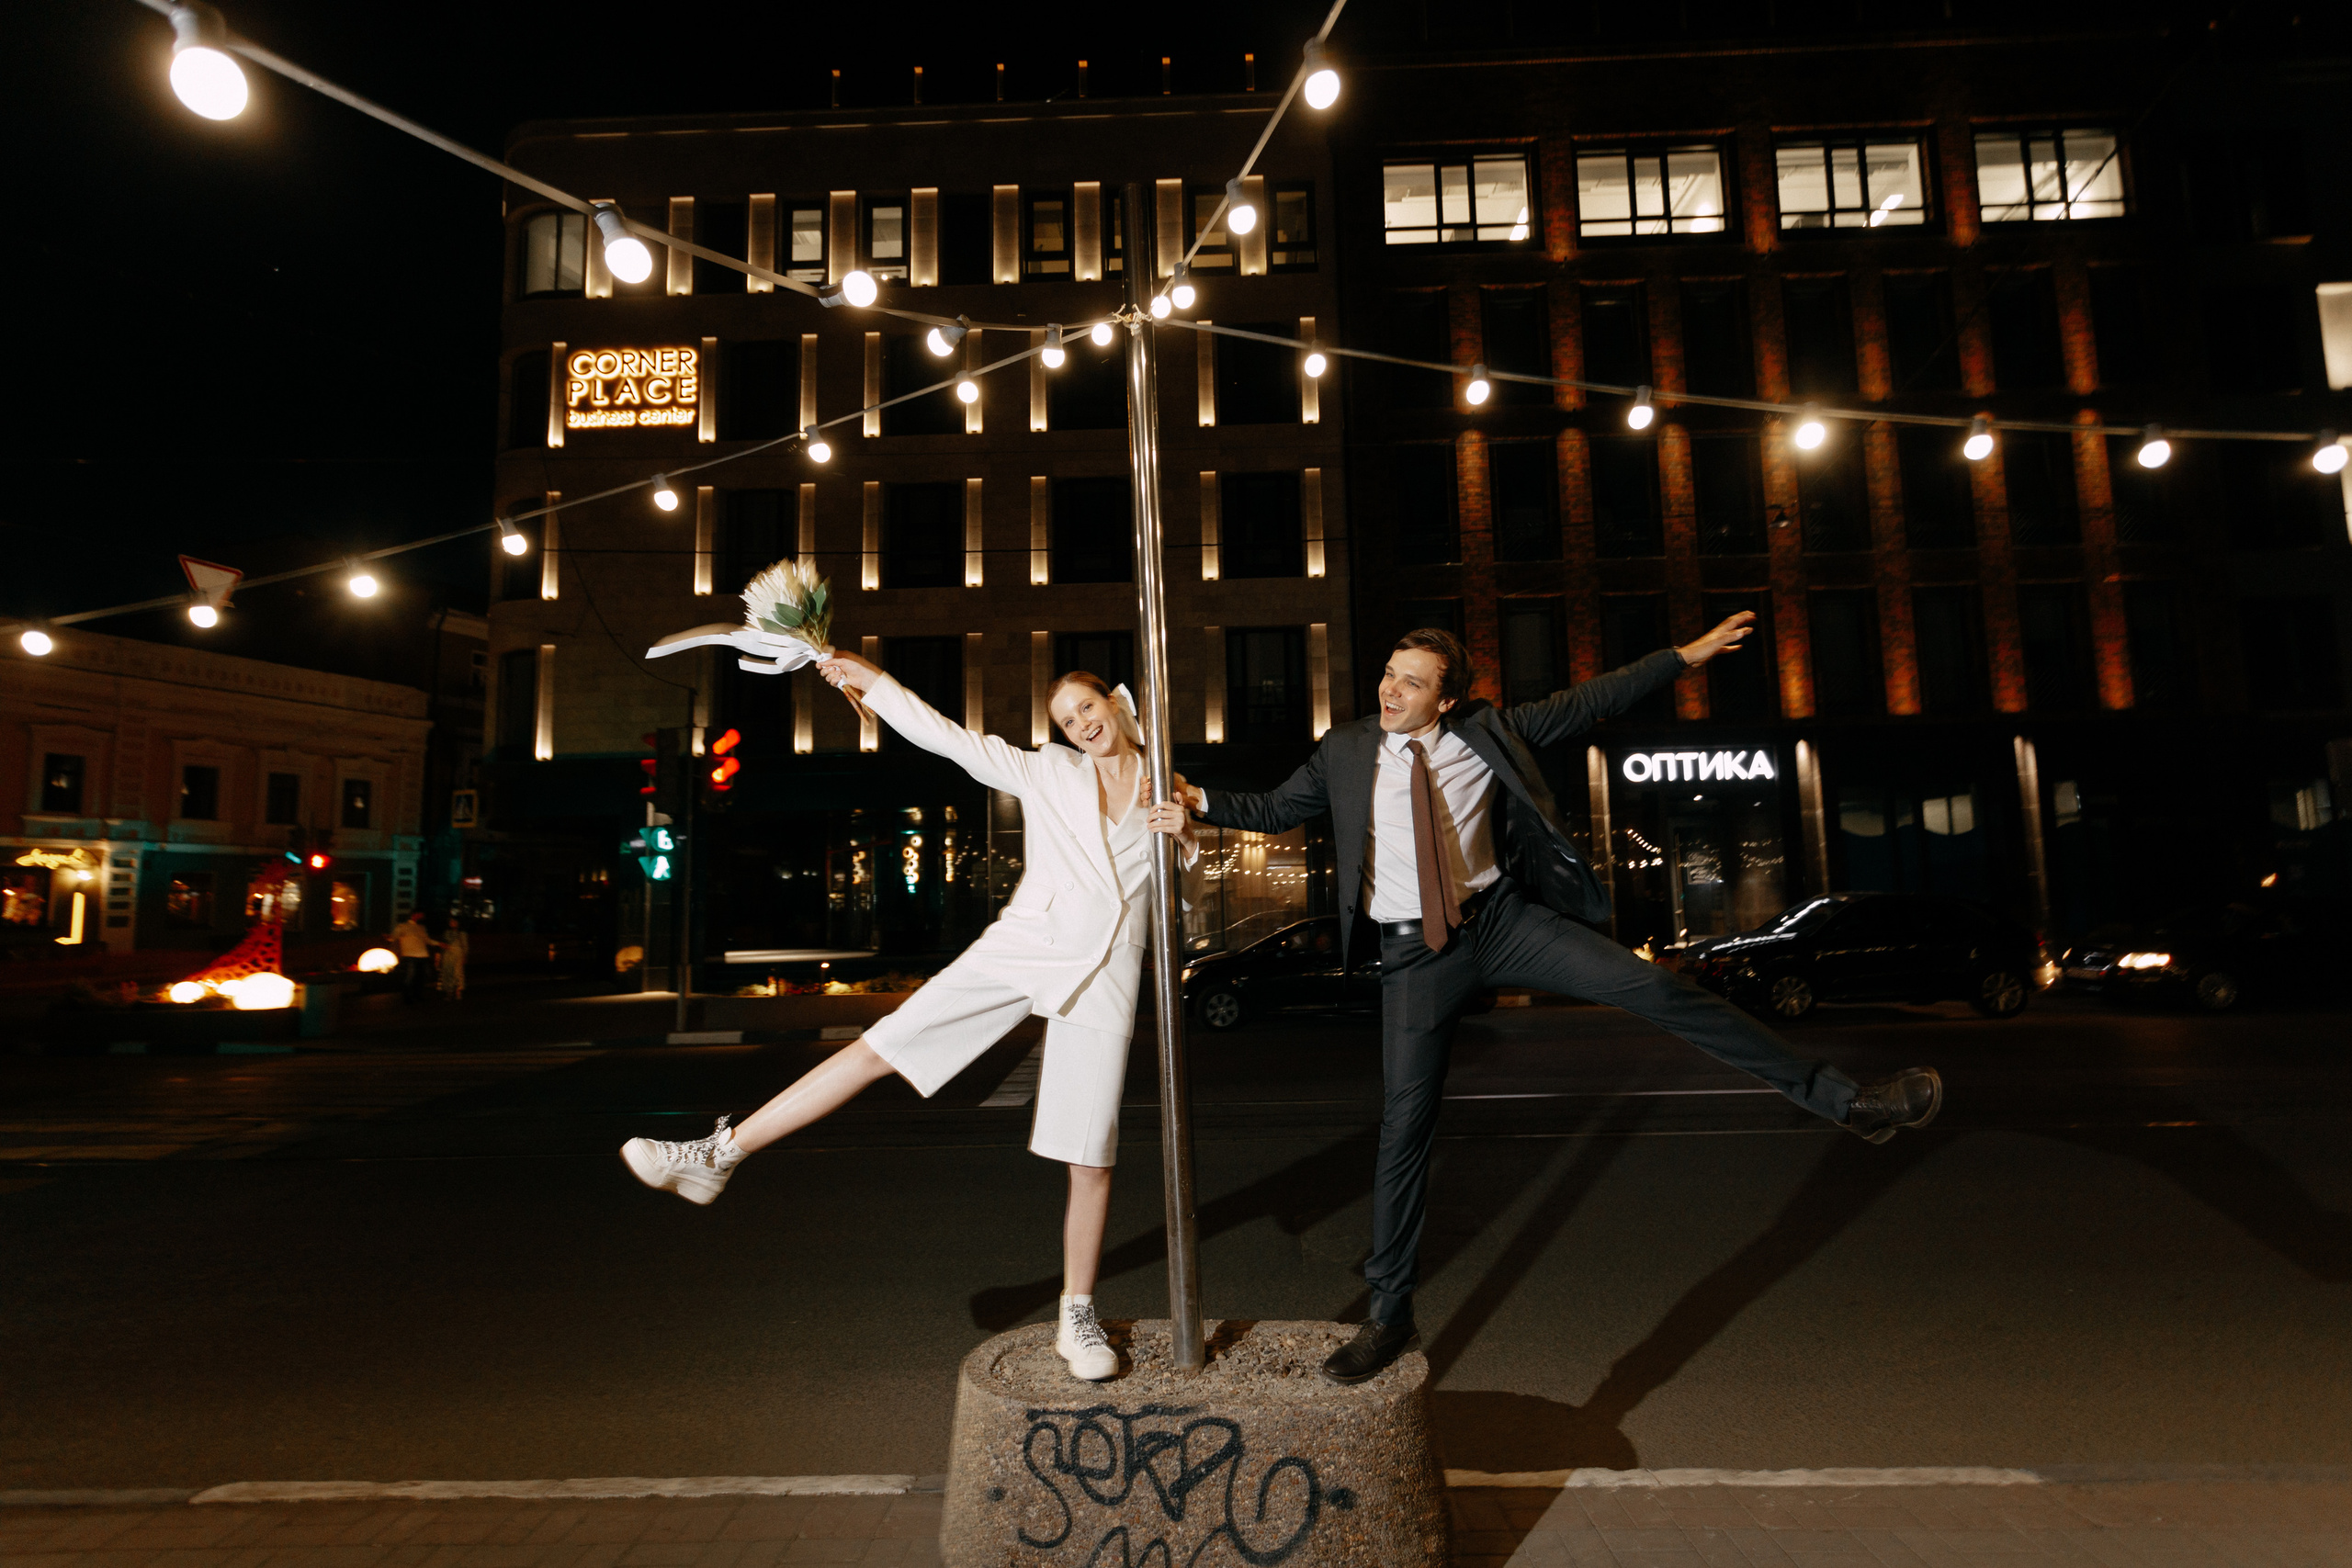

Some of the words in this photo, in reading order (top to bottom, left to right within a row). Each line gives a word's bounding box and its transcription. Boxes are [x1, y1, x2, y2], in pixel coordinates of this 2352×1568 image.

[568, 347, 697, 380] CORNER
[567, 375, 697, 407] PLACE
[567, 408, 636, 428] business
[638, 406, 695, 426] center
[1623, 750, 1775, 783] ОПТИКА
